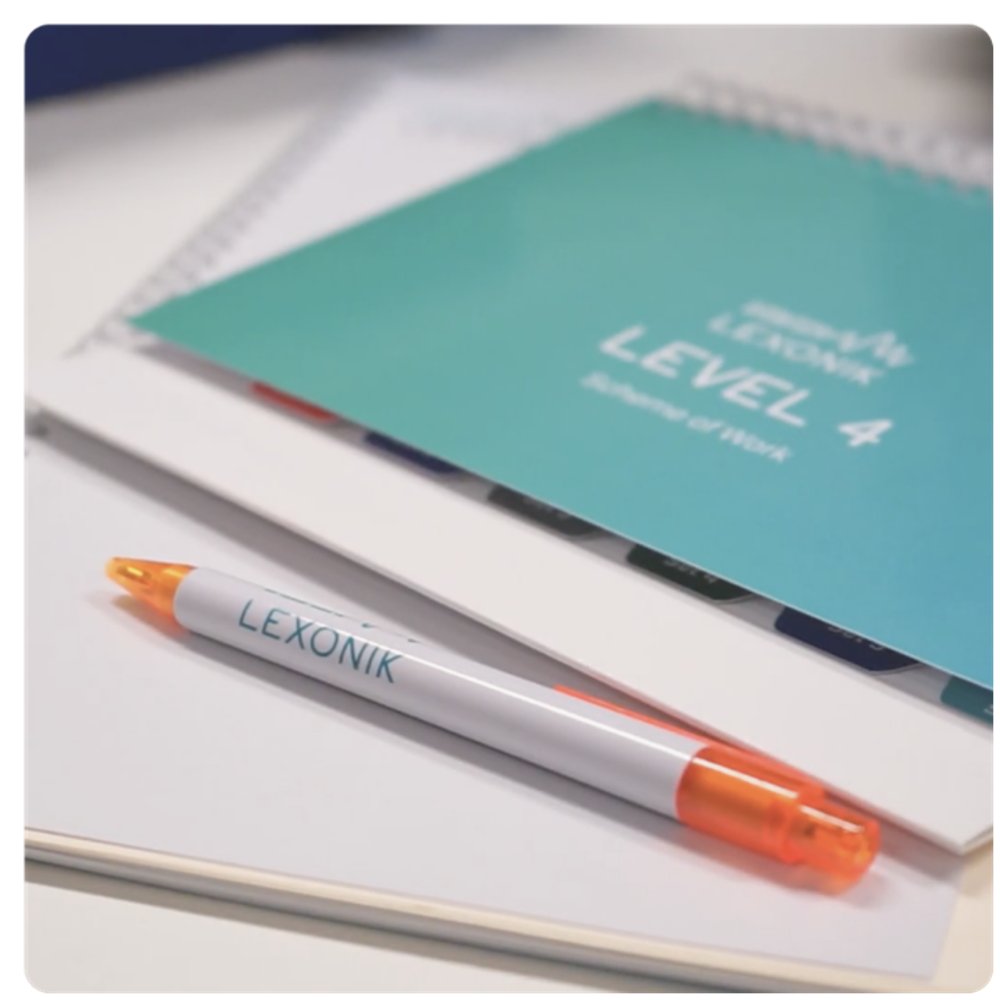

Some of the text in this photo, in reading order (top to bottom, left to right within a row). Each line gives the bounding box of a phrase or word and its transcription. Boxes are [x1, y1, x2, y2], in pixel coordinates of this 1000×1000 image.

[600, 324, 893, 448] LEVEL 4
[719, 424, 792, 463] Work
[238, 599, 404, 684] LEXONIK
